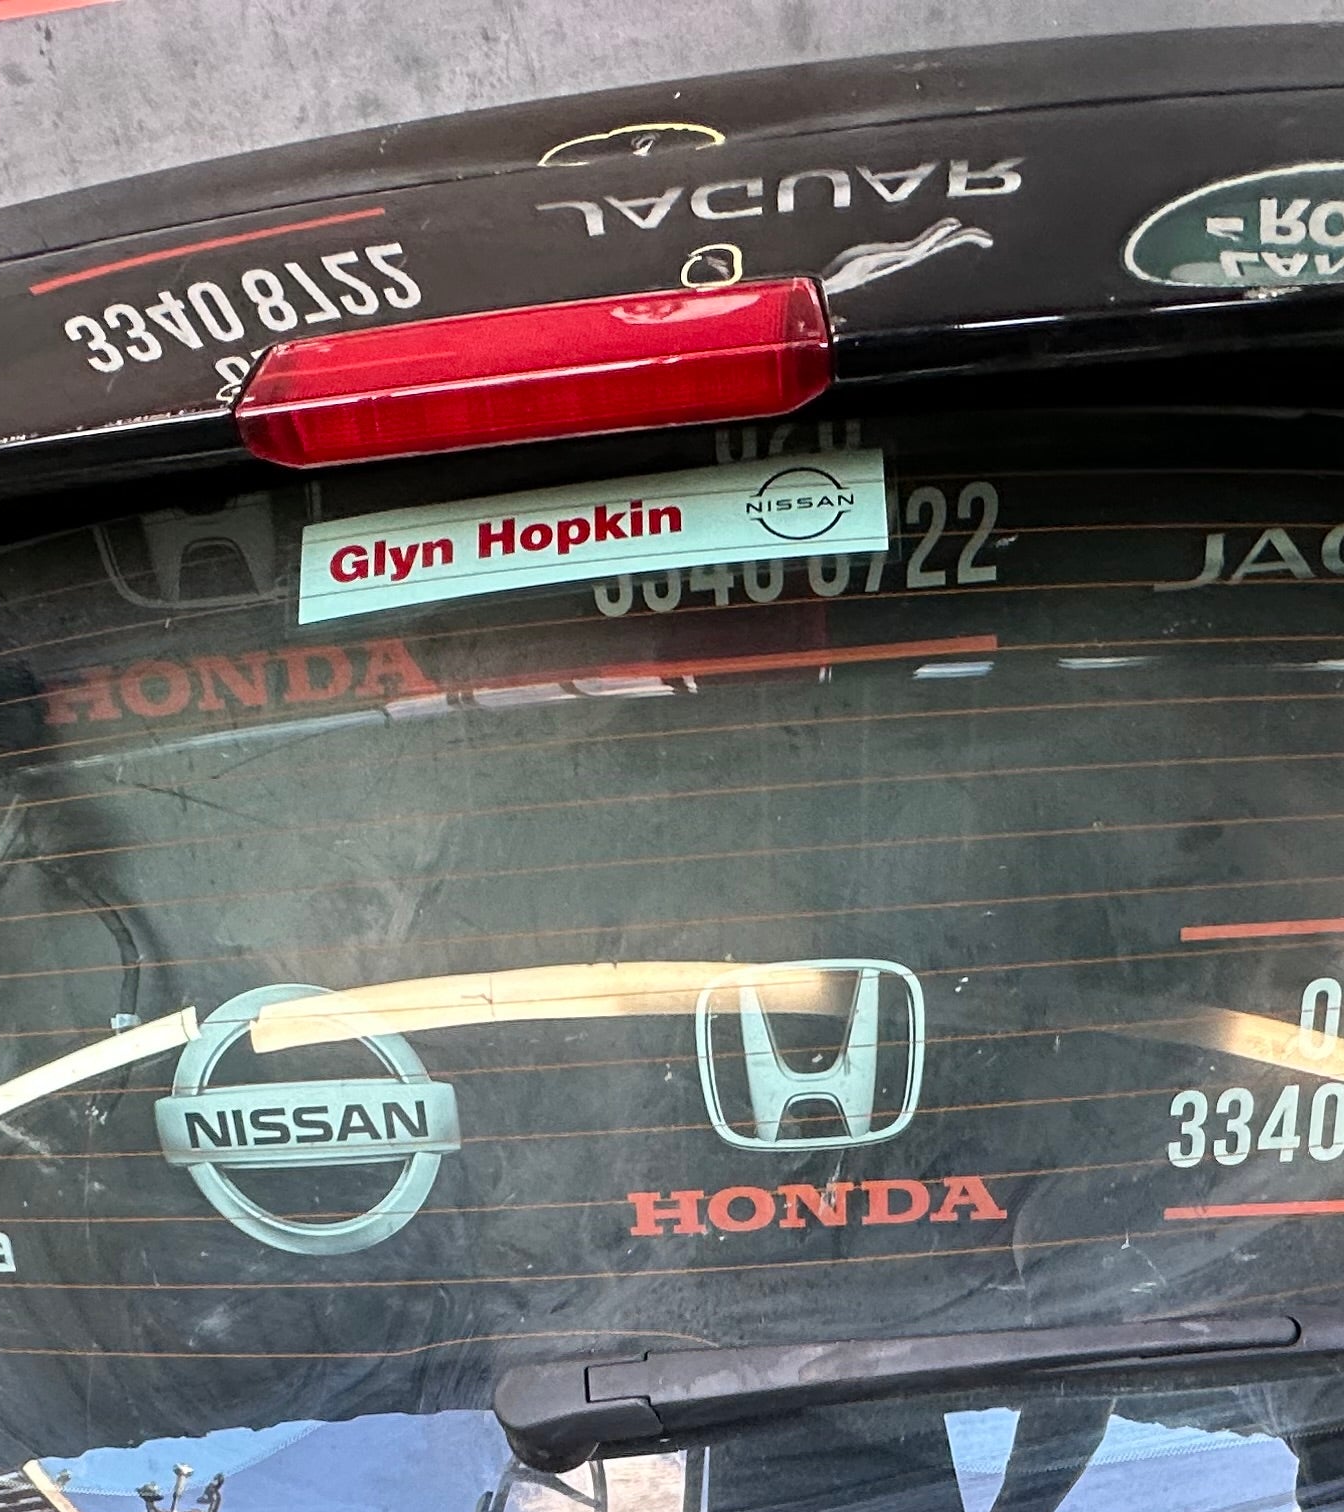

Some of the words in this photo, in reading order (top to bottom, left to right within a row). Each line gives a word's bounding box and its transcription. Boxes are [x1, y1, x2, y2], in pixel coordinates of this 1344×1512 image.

[746, 494, 854, 515] NISSAN
[329, 537, 454, 583] Glyn
[478, 499, 682, 559] Hopkin
[45, 638, 440, 724] HONDA
[184, 1100, 429, 1149] NISSAN
[627, 1175, 1008, 1237] HONDA
